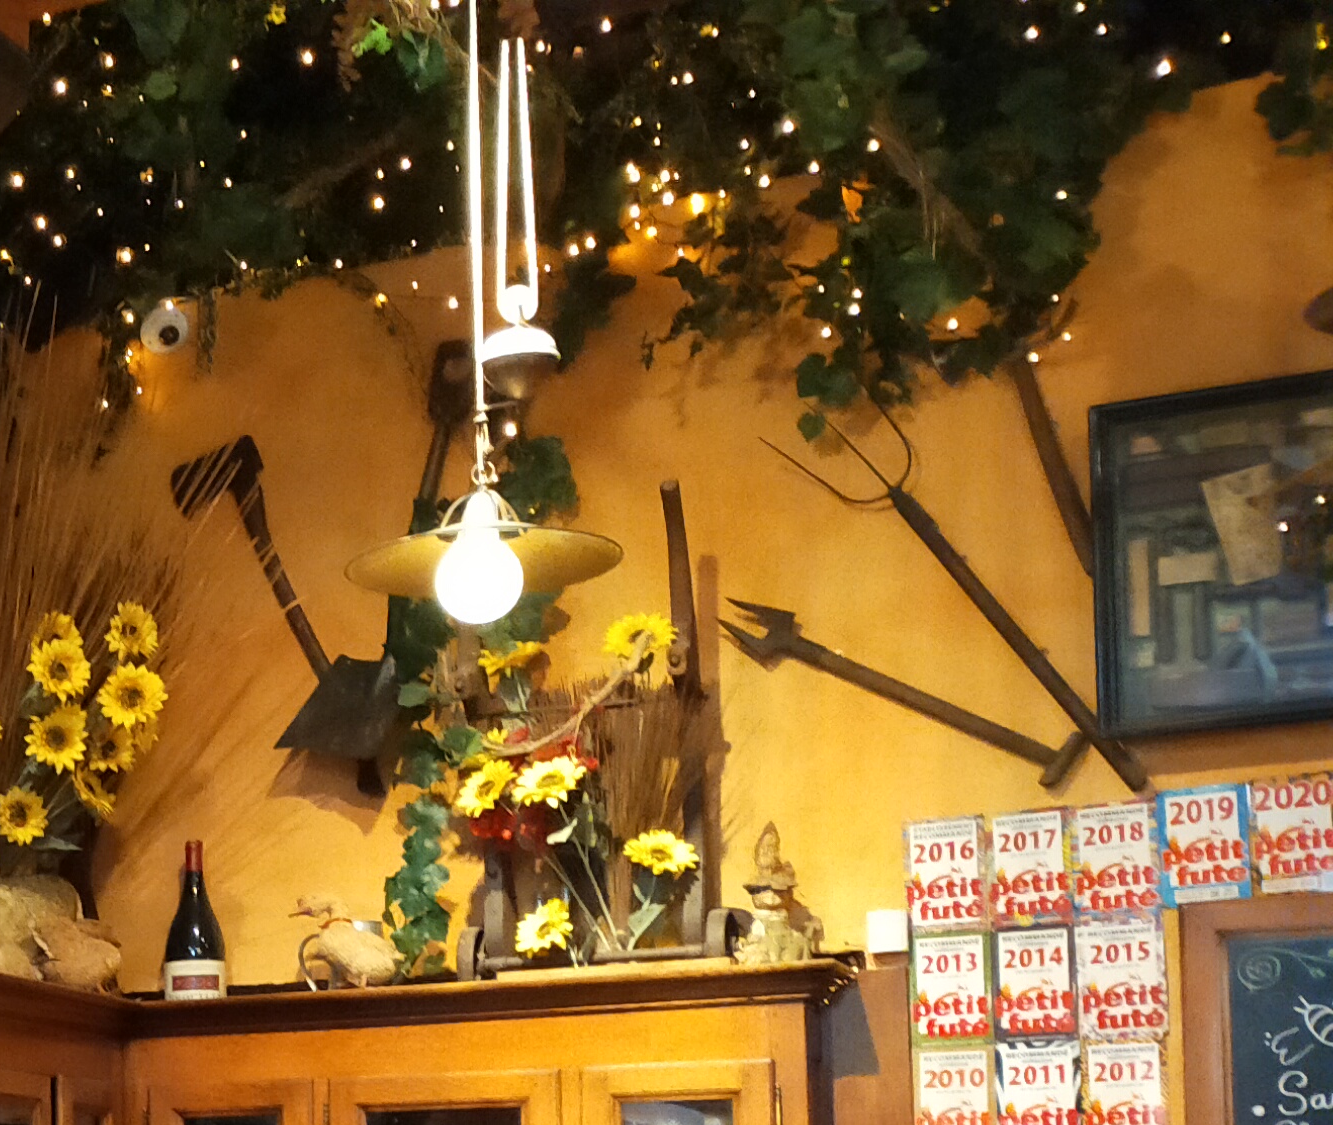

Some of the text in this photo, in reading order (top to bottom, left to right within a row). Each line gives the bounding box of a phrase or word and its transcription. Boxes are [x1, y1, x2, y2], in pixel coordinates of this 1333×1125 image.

[1254, 780, 1333, 811] 2020
[1170, 796, 1235, 826] 2019
[998, 829, 1057, 852] 2017
[1083, 821, 1144, 846] 2018
[913, 840, 975, 864] 2016
[1163, 837, 1245, 872] petit
[906, 872, 983, 908] petit
[989, 867, 1070, 903] petit
[1076, 861, 1160, 895] petit
[922, 953, 977, 974] 2013
[1004, 946, 1063, 968] 2014
[1090, 941, 1150, 964] 2015
[913, 992, 989, 1023] petit
[995, 983, 1074, 1018] petit
[1083, 982, 1164, 1014] petit
[923, 1068, 984, 1088] 2010
[1008, 1064, 1066, 1085] 2011
[1093, 1060, 1155, 1082] 2012
